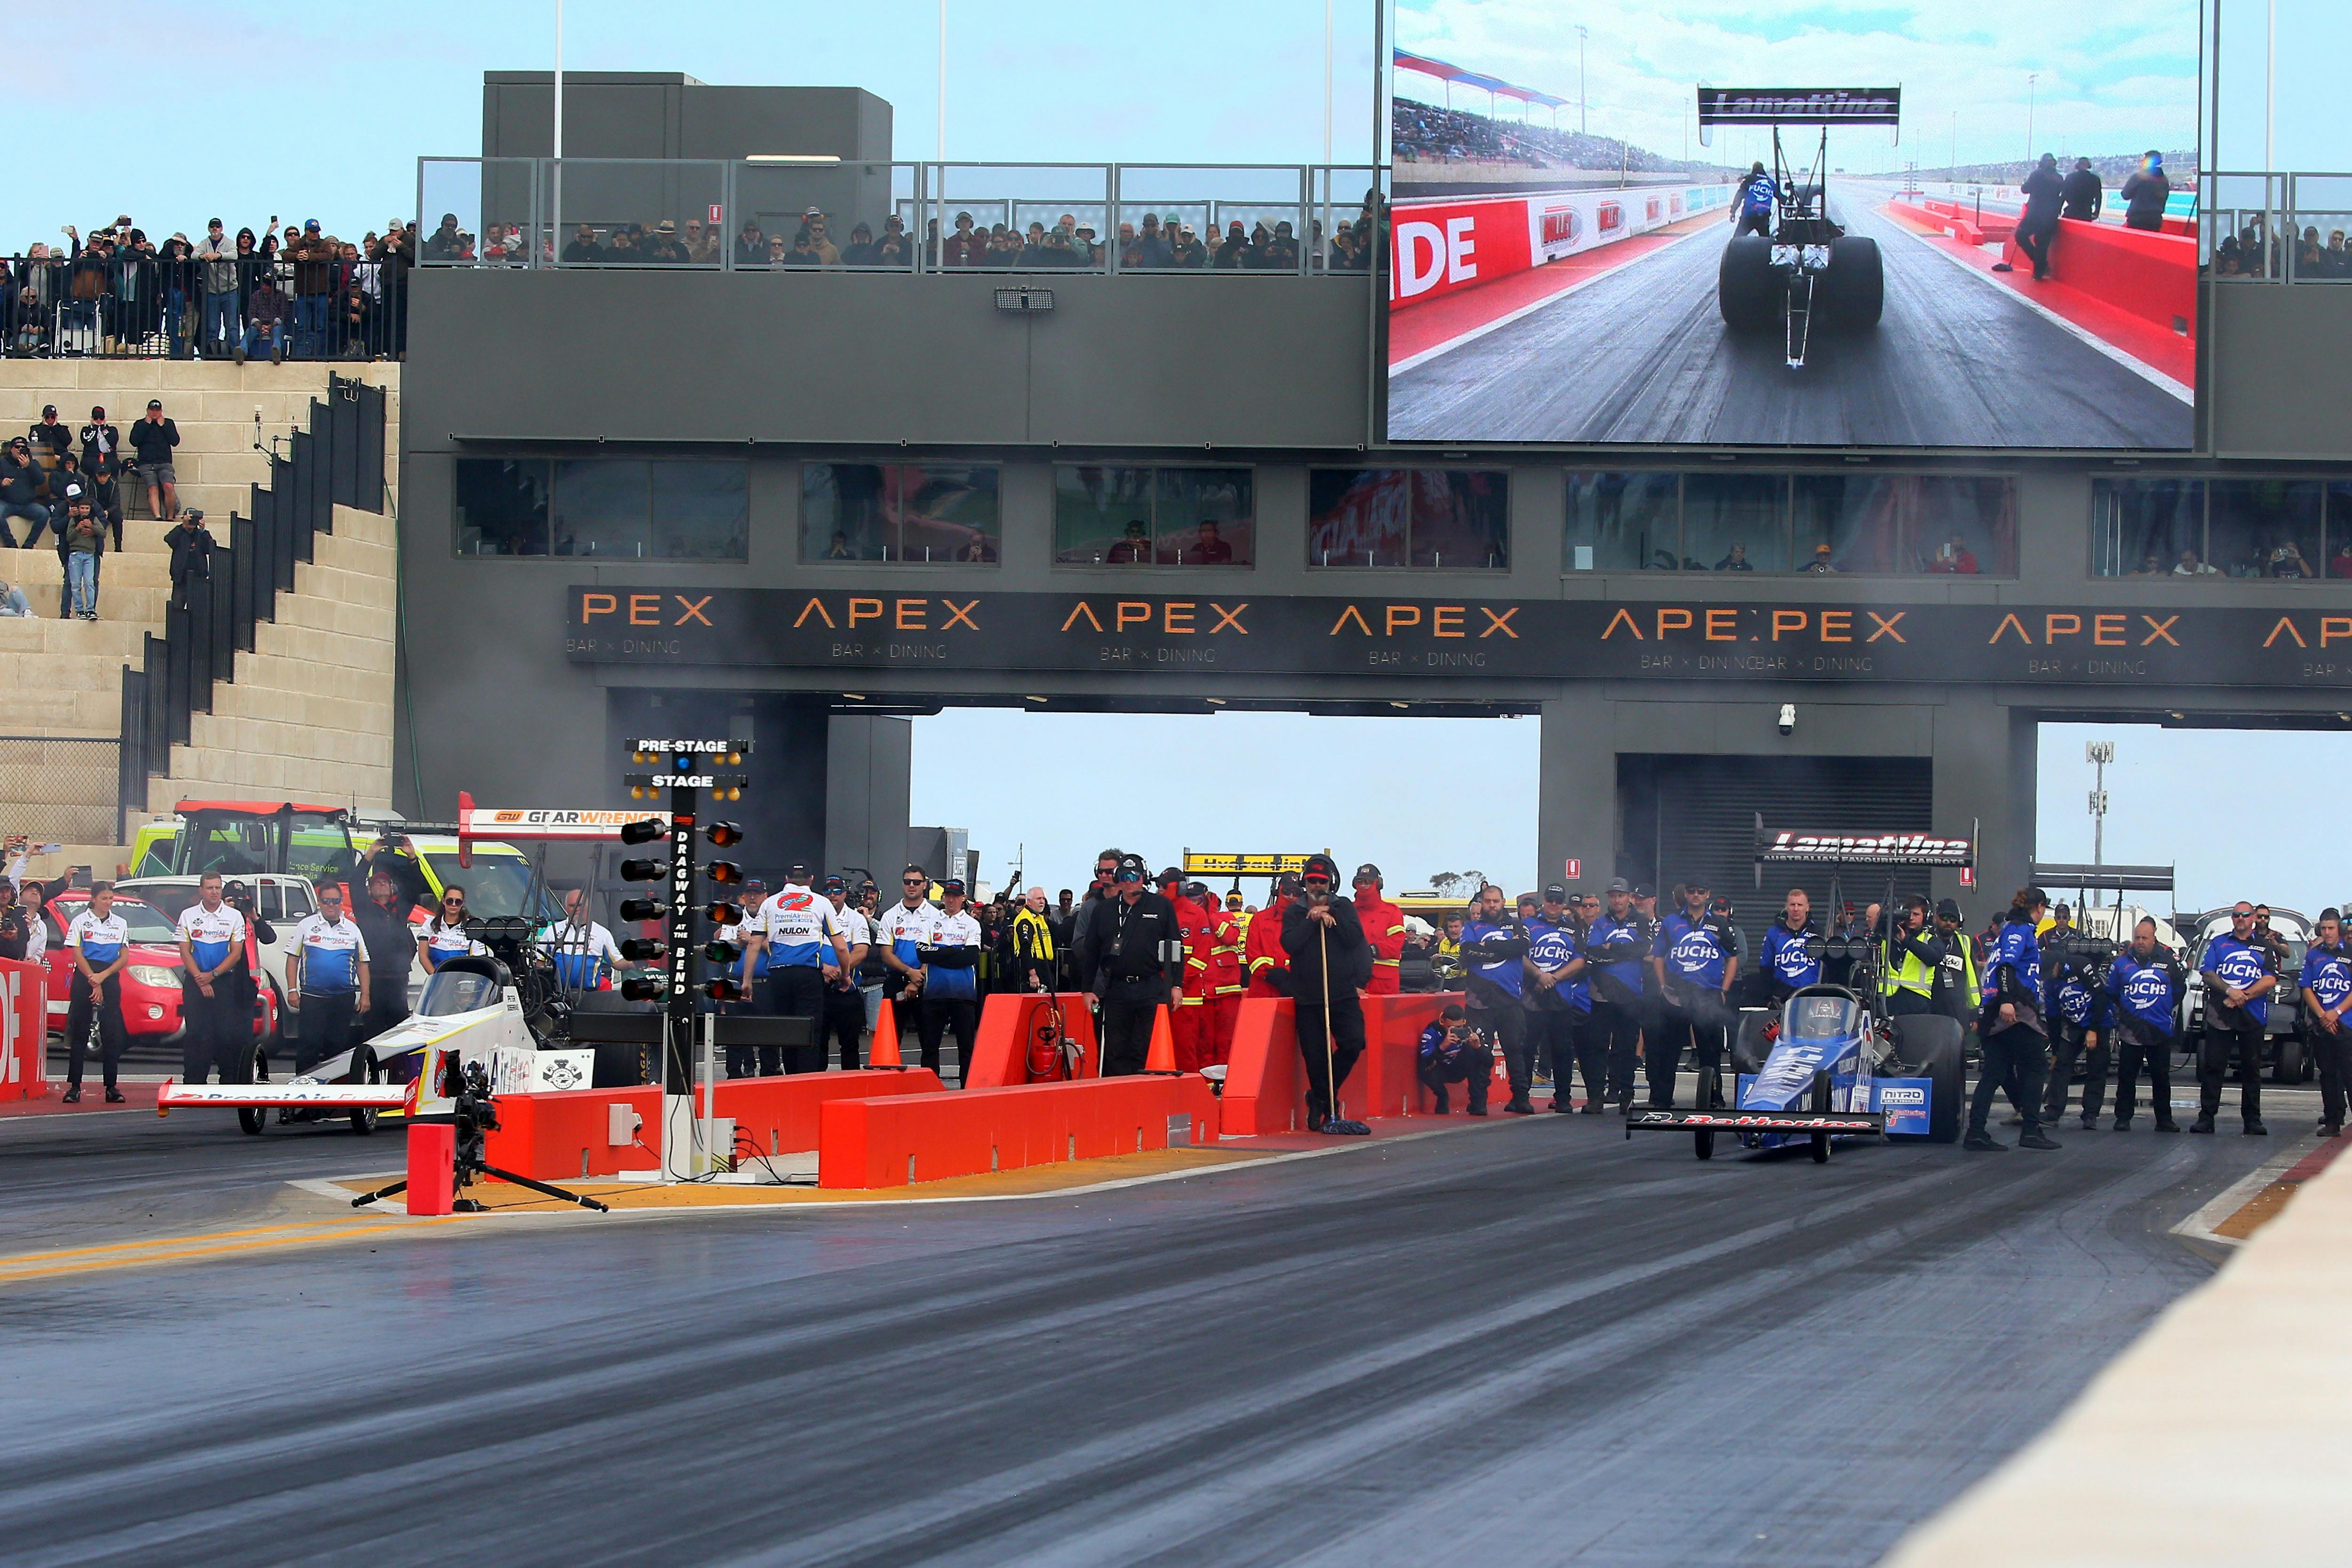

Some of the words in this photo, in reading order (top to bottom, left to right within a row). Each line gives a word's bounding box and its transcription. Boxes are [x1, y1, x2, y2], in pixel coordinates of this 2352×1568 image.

[1713, 92, 1889, 114] Lamattina
[1390, 217, 1477, 298] DE
[583, 594, 712, 625] PEX
[794, 598, 979, 629] APEX
[1061, 602, 1249, 634] APEX
[1330, 605, 1519, 638] APEX
[1601, 608, 1758, 641] APE
[1772, 610, 1906, 642] PEX
[1989, 613, 2180, 646] APEX
[567, 639, 597, 652] BAR
[624, 640, 680, 653] DINING
[833, 644, 863, 657] BAR
[890, 645, 946, 658] DINING
[1101, 648, 1131, 661] BAR
[1158, 649, 1215, 662] DINING
[1369, 652, 1400, 665] BAR
[1428, 653, 1486, 666] DINING
[1641, 655, 1671, 668] BAR
[1756, 657, 1787, 670] BAR
[1815, 658, 1872, 671] DINING
[2029, 661, 2061, 673] BAR
[2089, 661, 2146, 675] DINING
[2304, 664, 2335, 677] BAR
[638, 740, 727, 752] PRE-STAGE
[652, 775, 714, 788] STAGE
[1771, 832, 1970, 855] Lamattina
[310, 863, 338, 873] Service
[675, 831, 689, 916] DRAGWAY
[1529, 946, 1573, 962] FUCHS
[1671, 946, 1719, 959] FUCHS
[675, 947, 686, 994] BEND
[2216, 963, 2262, 979] FUCHS
[2123, 983, 2167, 996] FUCHS
[2312, 978, 2351, 992] FUCHS
[1683, 1115, 1871, 1127] Batteries
